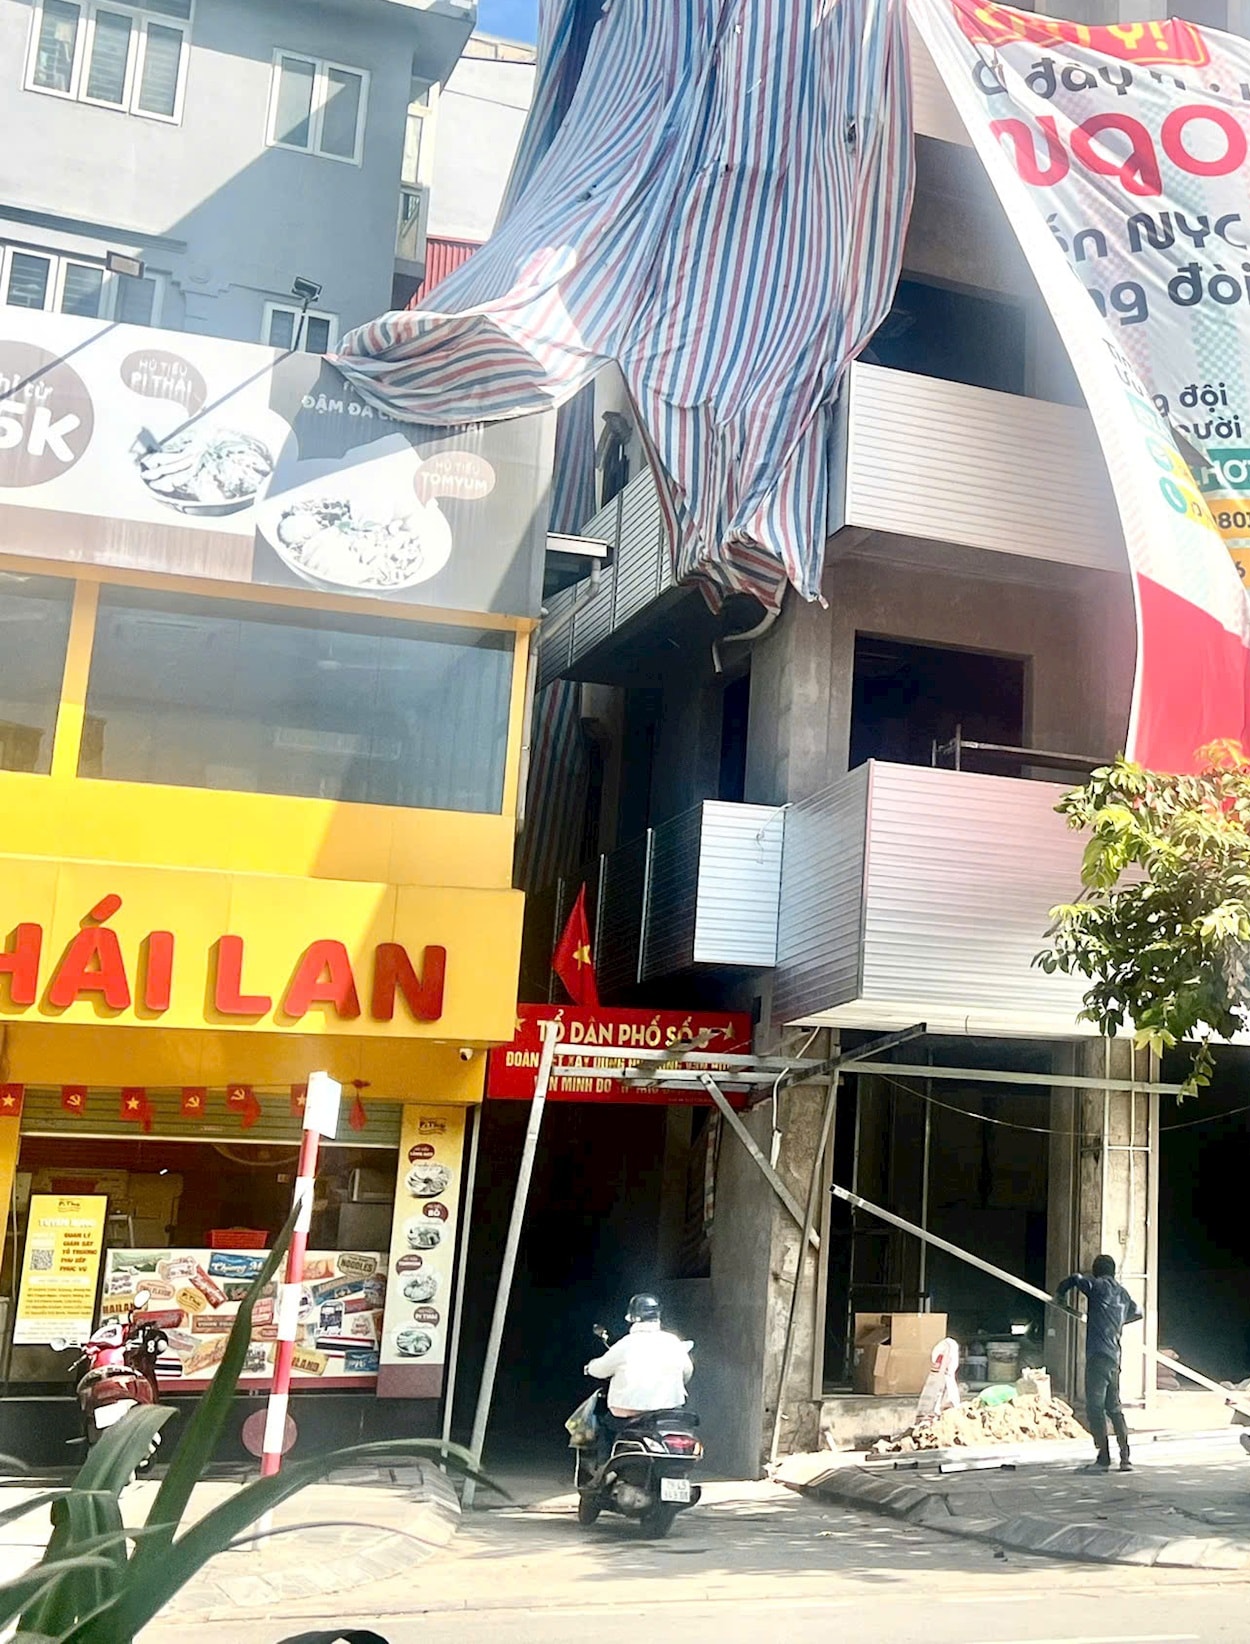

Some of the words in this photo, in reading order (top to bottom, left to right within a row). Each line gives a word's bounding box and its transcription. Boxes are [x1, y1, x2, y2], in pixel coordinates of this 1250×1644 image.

[301, 393, 343, 414] ĐẬM
[1179, 382, 1228, 413] đội
[212, 934, 447, 1022] LAN
[569, 1016, 613, 1045] DÂN
[618, 1015, 661, 1047] PHỐ
[505, 1048, 540, 1067] ĐOÀN
[561, 1076, 593, 1092] MINH
